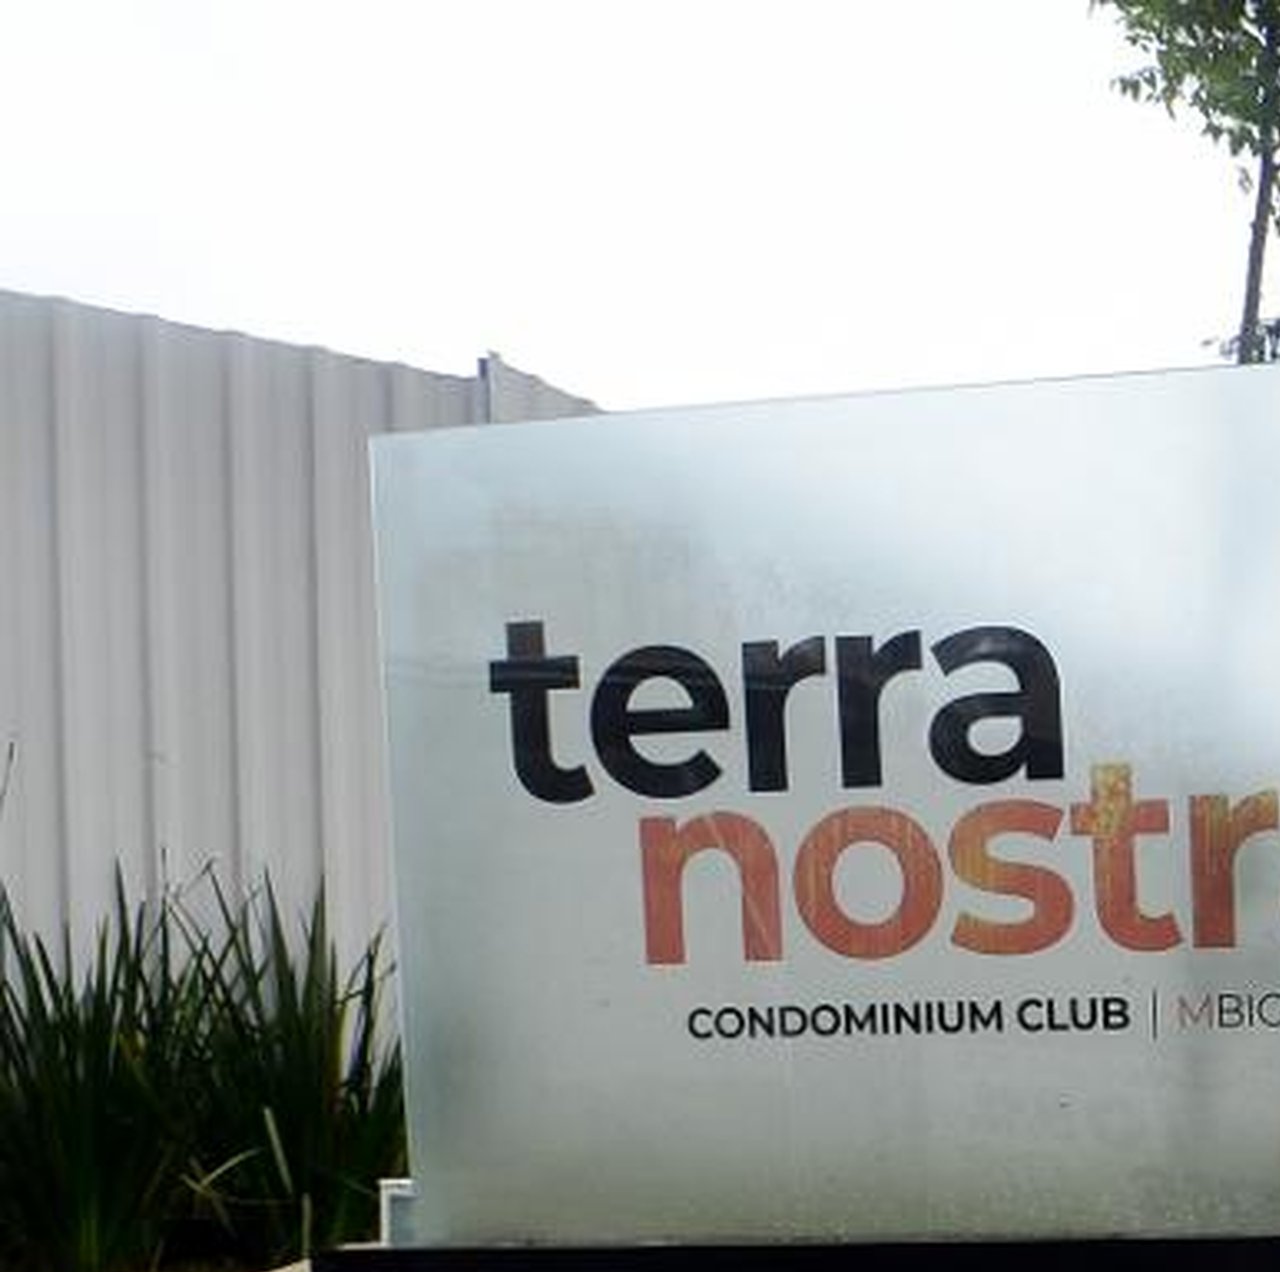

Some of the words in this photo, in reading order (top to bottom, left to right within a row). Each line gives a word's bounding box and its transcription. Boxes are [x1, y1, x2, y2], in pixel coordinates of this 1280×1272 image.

[489, 620, 1065, 803] terra
[687, 999, 1003, 1040] CONDOMINIUM
[1015, 997, 1131, 1032] CLUB
